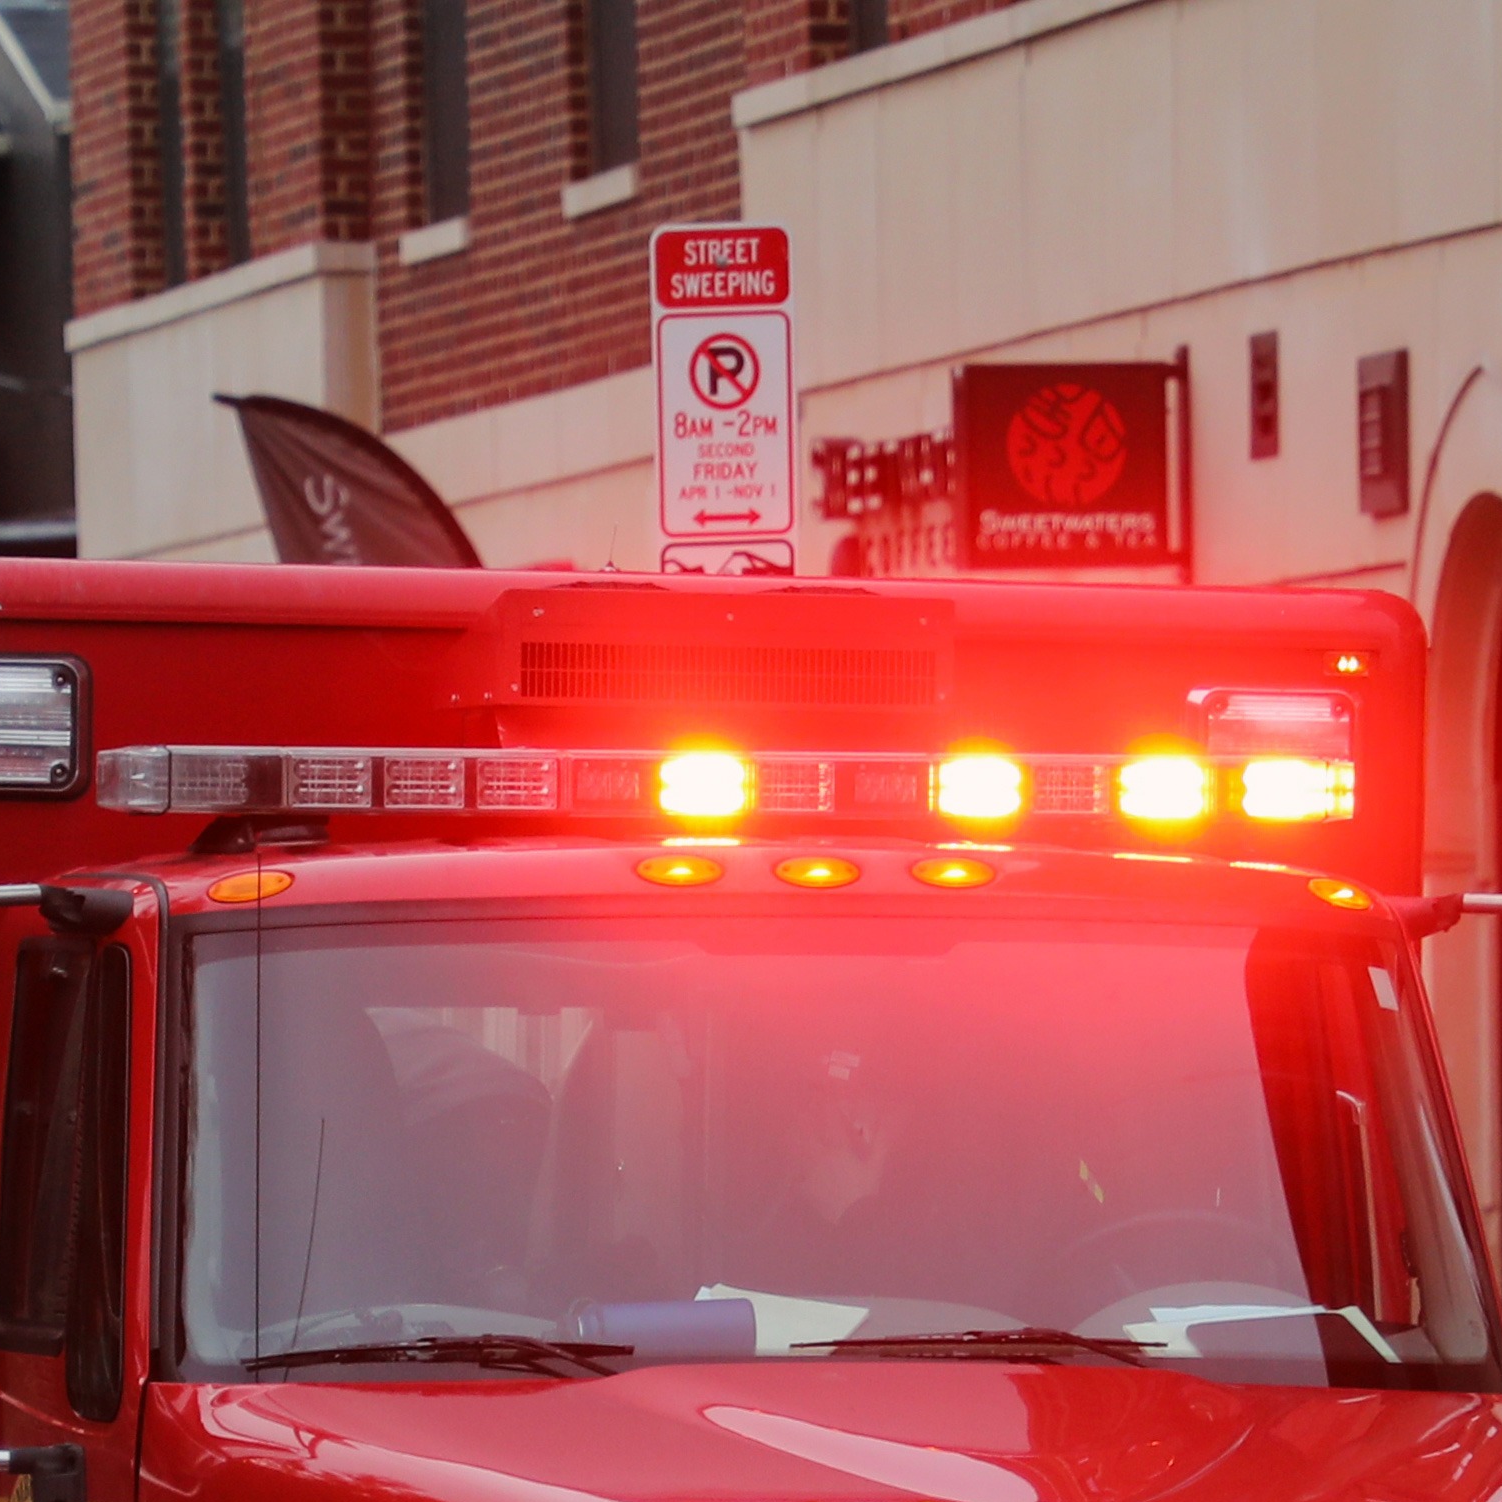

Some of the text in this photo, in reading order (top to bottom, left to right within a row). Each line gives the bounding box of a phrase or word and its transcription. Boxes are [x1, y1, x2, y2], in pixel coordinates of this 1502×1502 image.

[683, 237, 760, 267] STREET
[670, 269, 776, 299] SWEEPING
[674, 411, 713, 439] 8AM
[699, 443, 755, 458] SECOND
[693, 462, 758, 481] FRIDAY
